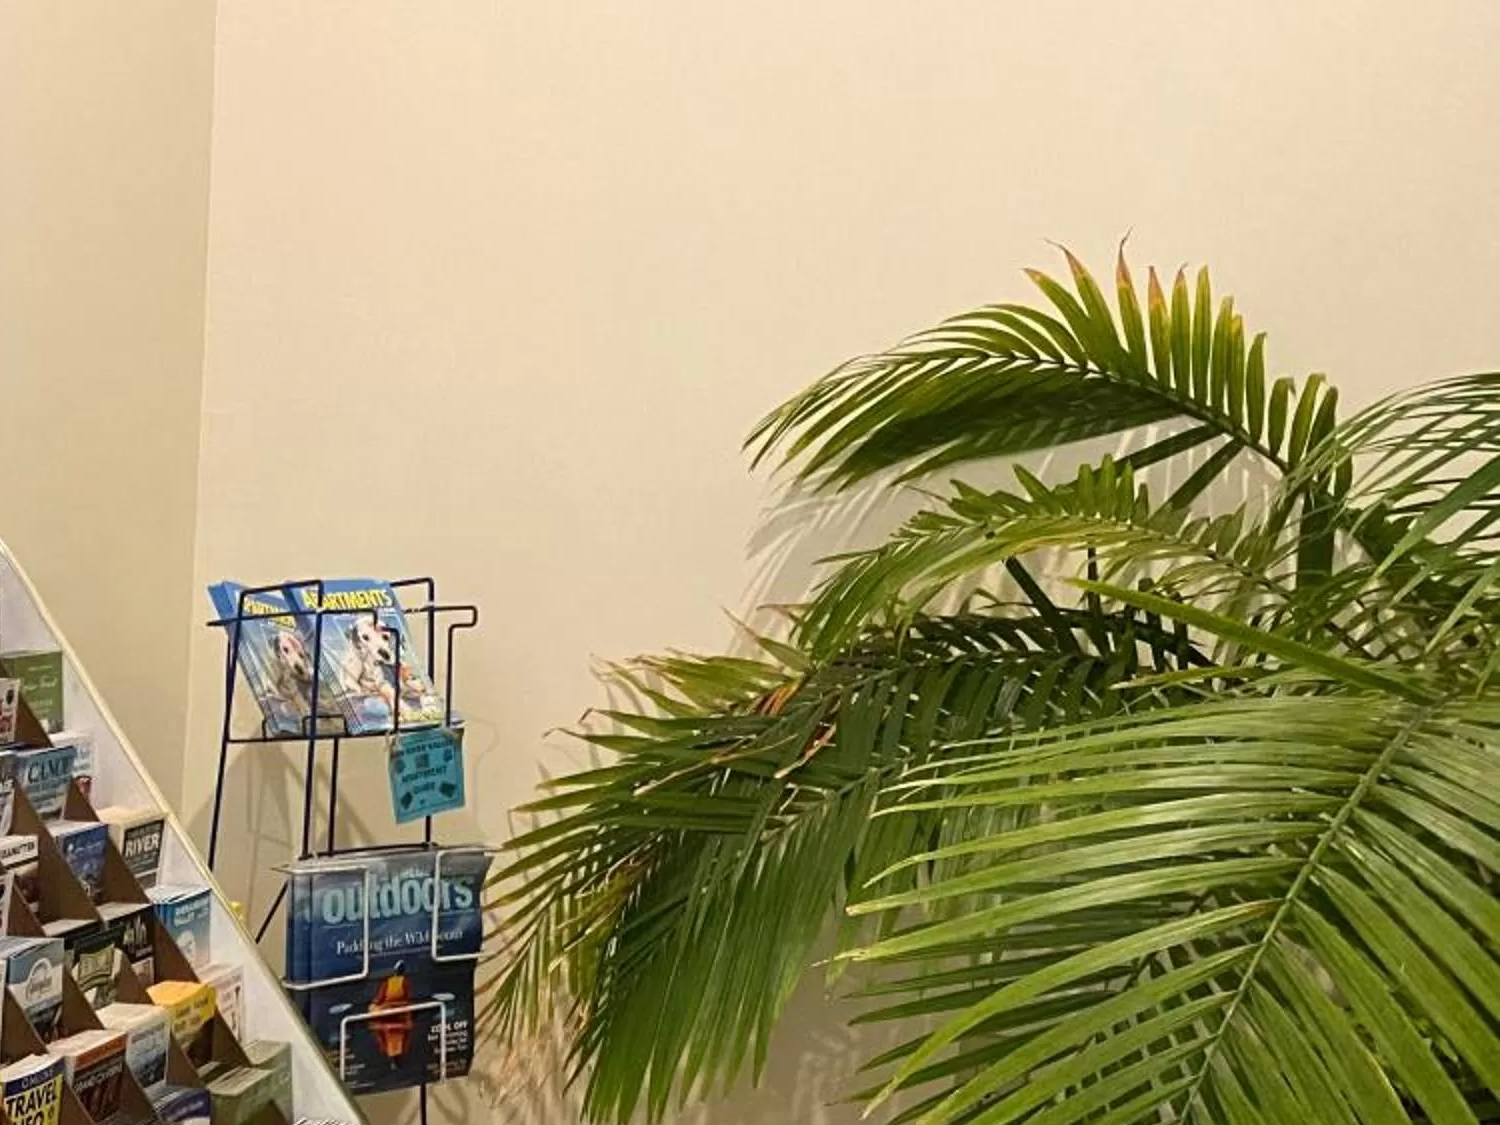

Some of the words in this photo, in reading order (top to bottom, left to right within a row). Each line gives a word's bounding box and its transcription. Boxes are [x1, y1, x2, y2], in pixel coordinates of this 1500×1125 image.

[303, 589, 393, 610] APARTMENTS
[125, 833, 159, 854] RIVER
[323, 873, 474, 925] outdoors
[6, 1080, 55, 1118] TRAVEL
